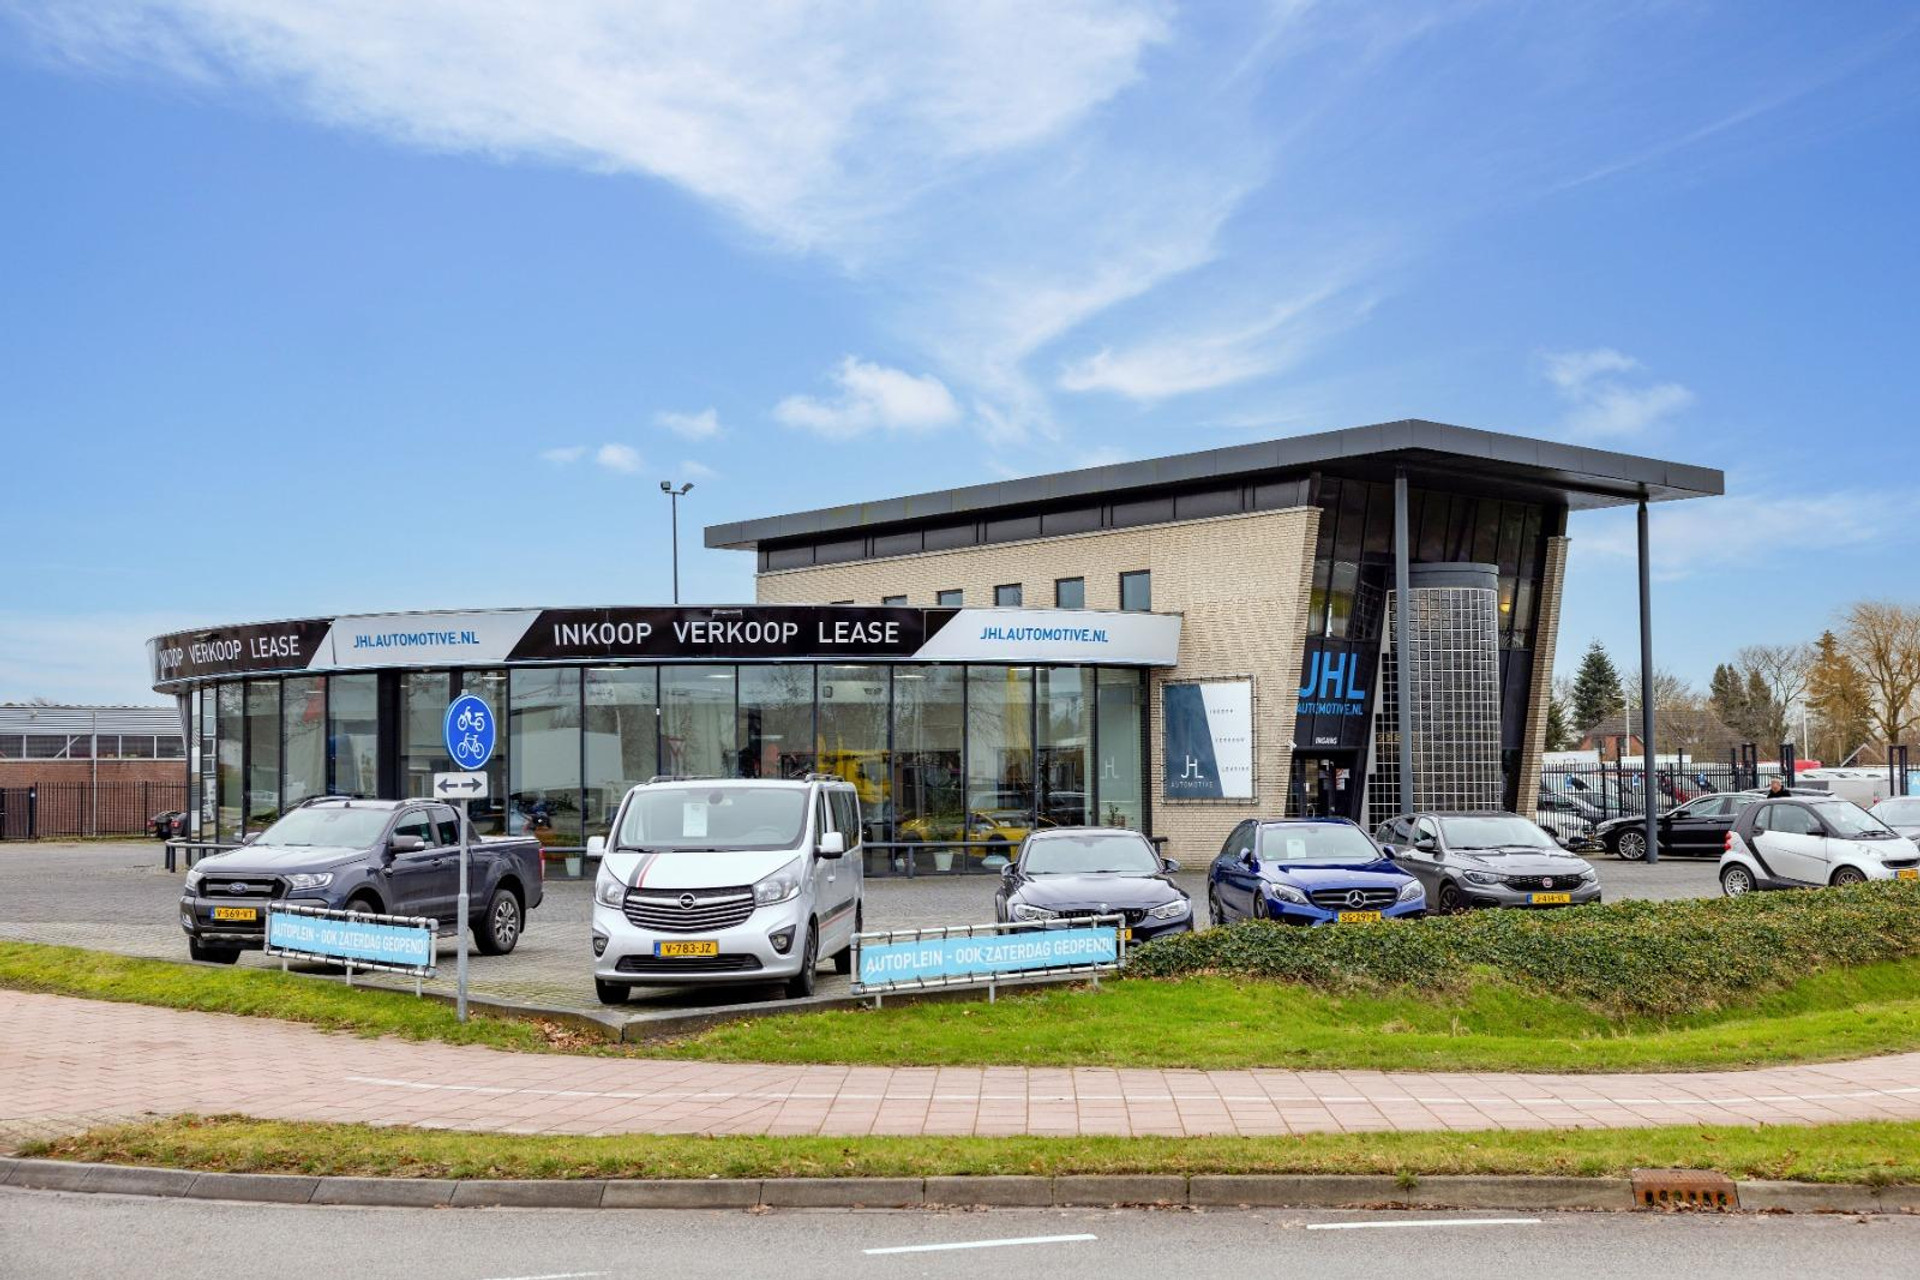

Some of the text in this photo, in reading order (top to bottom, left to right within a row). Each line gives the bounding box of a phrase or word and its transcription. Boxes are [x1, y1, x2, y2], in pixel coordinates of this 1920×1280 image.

[353, 630, 480, 650] JHLAUTOMOTIVE.NL
[553, 620, 899, 646] INKOOP VERKOOP LEASE
[980, 626, 1109, 644] JHLAUTOMOTIVE.NL
[188, 639, 243, 665] VERKOOP
[250, 634, 301, 659] LEASE
[1298, 651, 1366, 700] JHL
[272, 921, 315, 942] AUTOPLEIN
[321, 929, 338, 945] OOK
[338, 931, 382, 950] ZATERDAG
[382, 935, 427, 954] GEOPEND!
[665, 942, 712, 954] V-783-JZ
[865, 949, 943, 973] AUTOPLEIN
[955, 946, 982, 964] OOK
[985, 940, 1052, 962] ZATERDAG
